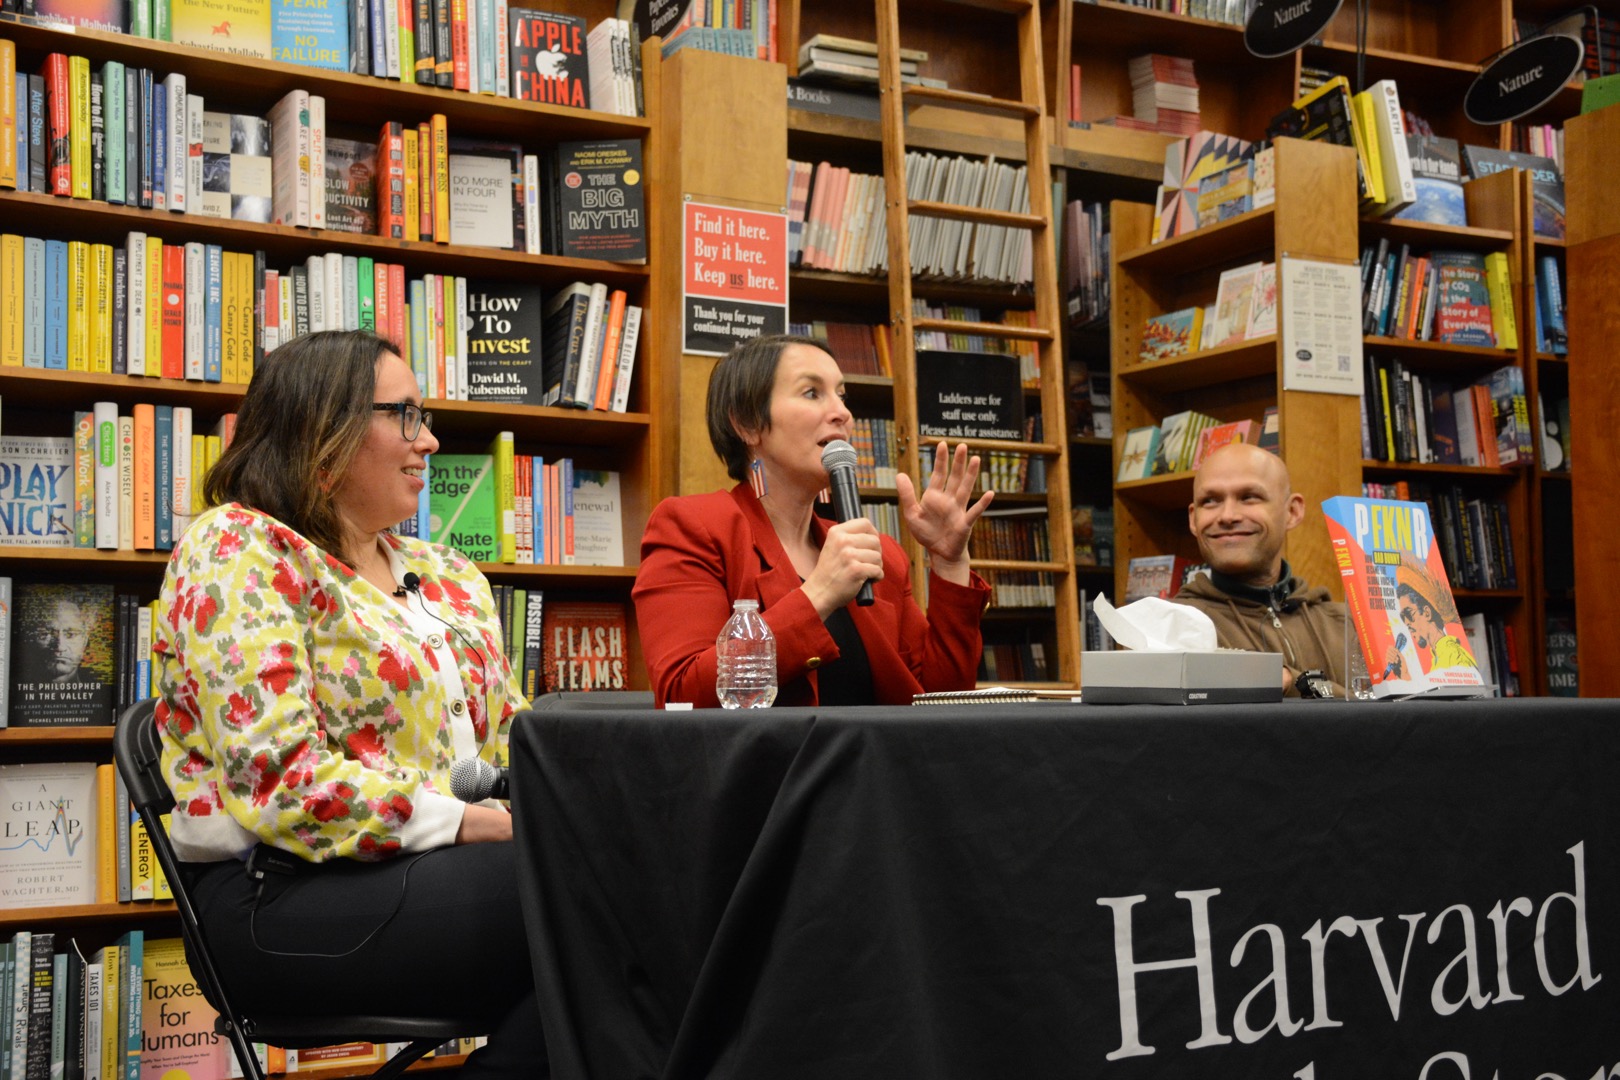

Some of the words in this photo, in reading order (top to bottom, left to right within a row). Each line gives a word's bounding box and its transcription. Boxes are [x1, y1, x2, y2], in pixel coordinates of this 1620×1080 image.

[227, 4, 260, 16] Future
[1273, 0, 1312, 28] Nature
[294, 35, 318, 48] NO
[514, 18, 582, 56] APPLE
[271, 47, 341, 63] FAILURE
[516, 70, 585, 108] CHINA
[1498, 65, 1544, 97] Nature
[32, 89, 43, 116] After
[91, 84, 102, 105] How
[796, 88, 831, 104] Books
[79, 102, 88, 123] Today
[175, 85, 184, 135] COMMUNICATION
[1388, 98, 1402, 136] EARTH
[32, 117, 43, 146] Steve
[299, 124, 308, 140] ARE
[156, 130, 164, 168] WHATEVER
[175, 135, 184, 179] INTELLIGENCE
[299, 143, 308, 157] WE
[327, 149, 361, 161] Newport
[574, 150, 596, 158] NAOMI
[596, 149, 627, 158] ORESKES
[299, 159, 308, 187] HERE?
[453, 175, 469, 185] DO
[471, 176, 503, 188] MORE
[588, 174, 616, 186] THE
[325, 178, 349, 190] SLOW
[453, 187, 464, 196] IN
[466, 187, 496, 198] FOUR
[581, 188, 624, 208] BIG
[569, 209, 639, 230] MYTH
[694, 212, 722, 235] Find
[725, 217, 735, 237] it
[738, 218, 770, 241] here.
[135, 239, 143, 277] EMPLOYMENT
[694, 237, 718, 261] Buy
[722, 241, 731, 261] it
[735, 242, 767, 265] here.
[116, 255, 125, 271] The
[210, 248, 219, 285] REMOTE,
[295, 275, 307, 295] HOW
[694, 262, 726, 288] Keep
[729, 273, 744, 288] us
[747, 269, 780, 291] here.
[1458, 269, 1480, 282] Story
[135, 290, 143, 307] DEAD
[210, 286, 220, 305] INC.
[296, 295, 308, 305] TO
[378, 281, 388, 316] VALLEY
[469, 293, 522, 312] How
[1451, 293, 1467, 304] the
[297, 306, 309, 317] BE
[314, 291, 322, 324] INVESTOR
[574, 301, 589, 323] The
[693, 305, 718, 319] Thank
[718, 311, 733, 322] you
[734, 309, 746, 323] for
[746, 315, 765, 326] your
[1442, 308, 1467, 320] Story
[1468, 308, 1479, 317] of
[226, 305, 237, 336] Canary
[241, 305, 252, 338] Canary
[479, 315, 512, 334] To
[693, 321, 731, 335] continued
[1443, 320, 1492, 335] Everything
[570, 325, 583, 355] Crux
[625, 321, 636, 341] WAR
[226, 337, 237, 361] Code
[242, 338, 252, 363] Code
[621, 342, 632, 373] BELOW
[472, 372, 504, 384] David
[506, 373, 521, 384] M.
[467, 384, 528, 396] Rubenstein
[938, 392, 972, 405] Ladders
[973, 396, 987, 406] are
[988, 394, 1002, 406] for
[941, 408, 961, 420] staff
[961, 411, 977, 421] use
[977, 410, 999, 425] only.
[79, 420, 90, 451] Over
[103, 425, 112, 443] Click
[920, 424, 948, 436] Please
[948, 425, 963, 437] ask
[963, 425, 977, 437] for
[978, 427, 1021, 439] assistance.
[25, 447, 69, 455] SCHREIER
[103, 445, 112, 463] Here
[79, 453, 90, 487] Work
[161, 450, 169, 486] INTENTION
[430, 465, 451, 479] On
[454, 465, 483, 480] the
[0, 462, 70, 502] PLAY
[122, 466, 131, 498] WISELY
[161, 486, 170, 520] ECONOMY
[0, 502, 67, 537] NICE
[449, 532, 492, 546] Nate
[1369, 598, 1397, 611] RESISTANCE
[527, 594, 543, 649] POSSIBLE
[554, 626, 621, 658] FLASH
[1546, 653, 1564, 666] OF
[555, 660, 623, 689] TEAMS
[17, 683, 34, 691] THE
[38, 682, 101, 691] PHILOSOPHER
[25, 693, 32, 701] IN
[60, 692, 94, 701] VALLEY
[38, 783, 47, 793] A
[12, 799, 74, 812] GIANT
[5, 819, 80, 838] LEAP
[119, 794, 127, 844] CRISIS-READY
[138, 832, 150, 880] ENERGY
[17, 874, 64, 885] ROBERT
[2, 886, 64, 897] WACHTER,
[65, 885, 80, 893] MD
[1096, 840, 1602, 1061] Harvard
[107, 951, 116, 972] How
[155, 961, 178, 969] Hannah
[89, 971, 100, 996] TAXES
[107, 973, 116, 983] to
[144, 977, 204, 1002] Taxes
[89, 998, 100, 1012] 101
[160, 1003, 191, 1028] for
[15, 1019, 27, 1049] Rivals
[78, 1008, 86, 1069] PERSONAL
